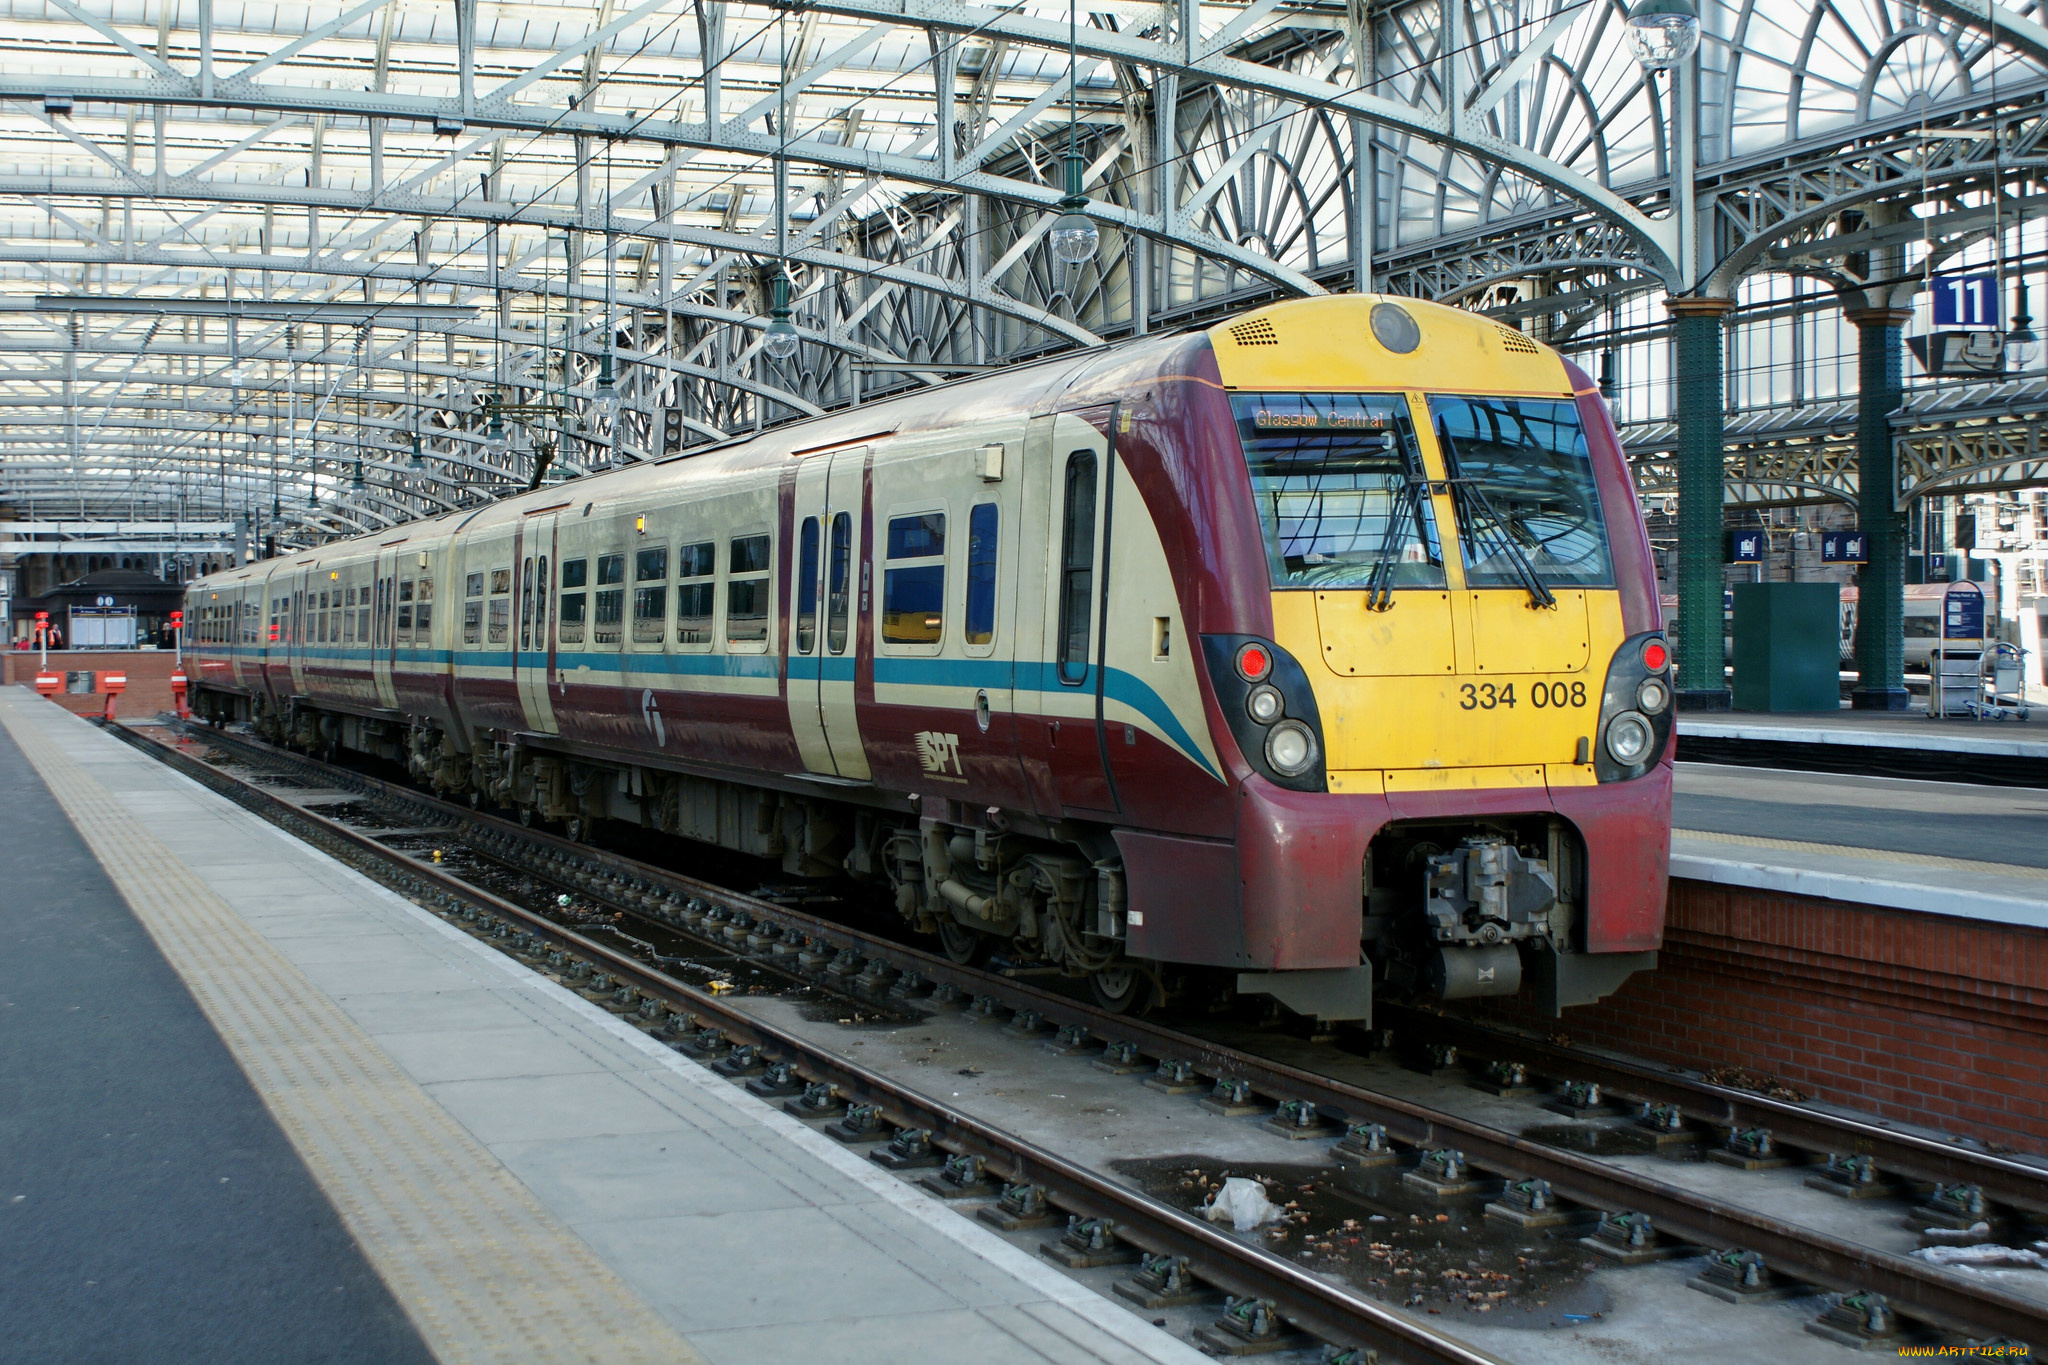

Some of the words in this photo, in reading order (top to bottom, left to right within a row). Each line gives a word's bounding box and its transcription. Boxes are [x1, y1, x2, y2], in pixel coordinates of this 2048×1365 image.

[1948, 279, 1983, 323] 11
[1256, 410, 1318, 427] Glasgow
[1327, 411, 1384, 428] Central
[1459, 683, 1517, 710] 334
[1531, 681, 1587, 708] 008
[913, 731, 963, 775] SPT
